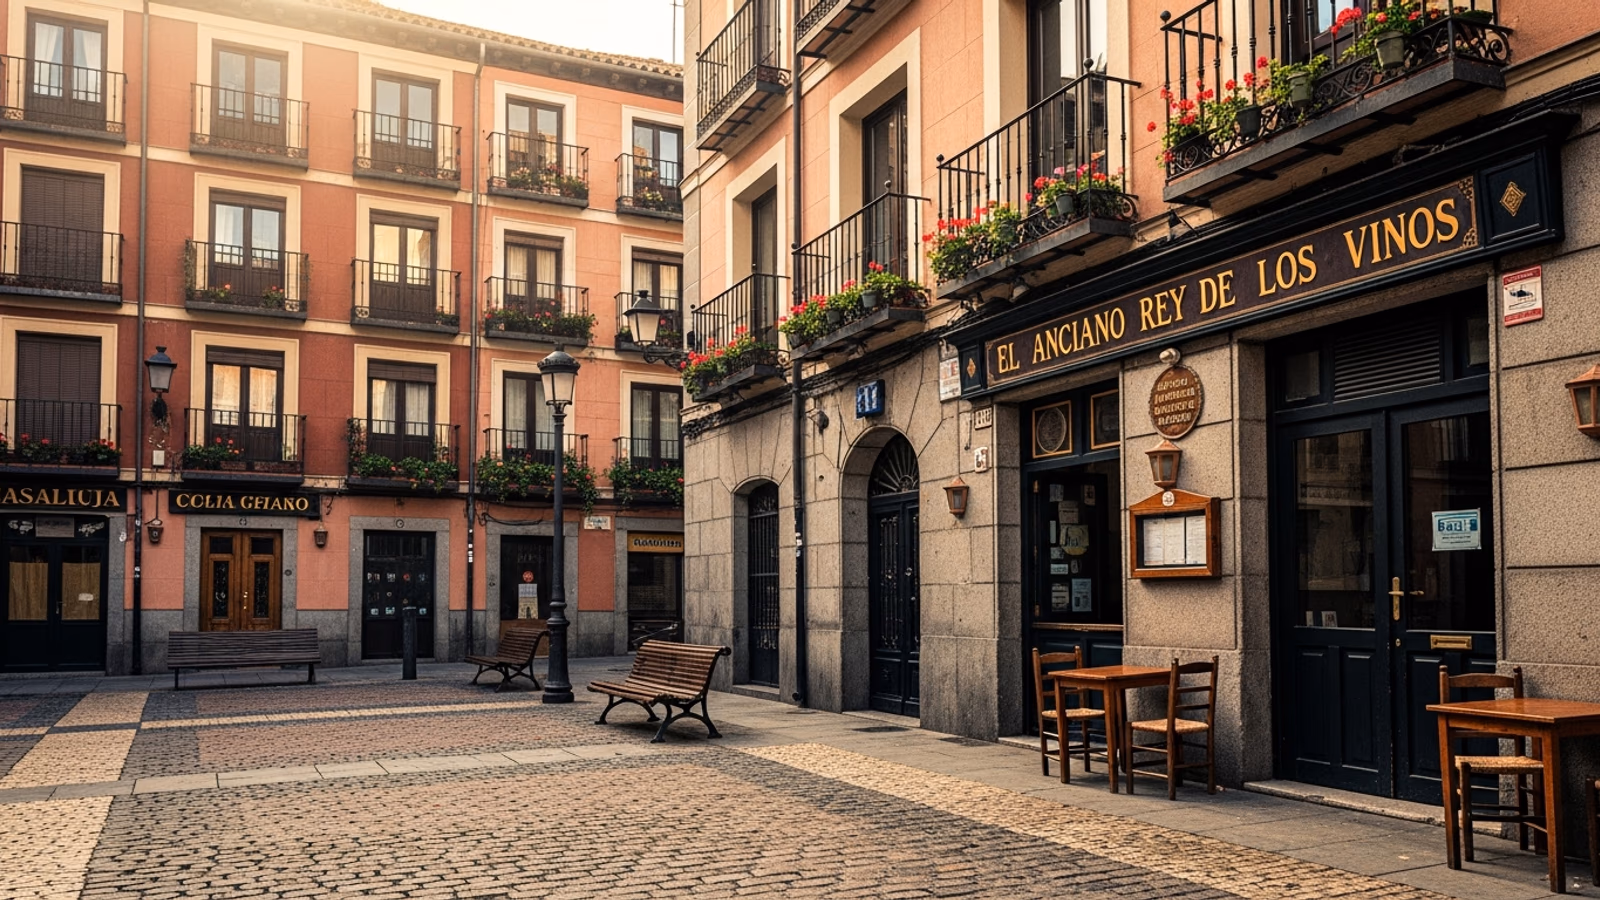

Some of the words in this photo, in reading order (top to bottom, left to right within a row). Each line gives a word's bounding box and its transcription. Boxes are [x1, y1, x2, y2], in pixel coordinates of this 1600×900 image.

[997, 342, 1020, 374] EL
[1032, 307, 1126, 365] ANCIANO
[1138, 284, 1187, 332] REY
[1199, 269, 1236, 314] DE
[1257, 244, 1317, 297] LOS
[1343, 198, 1459, 269] VINOS
[0, 487, 120, 508] ASALIUJA
